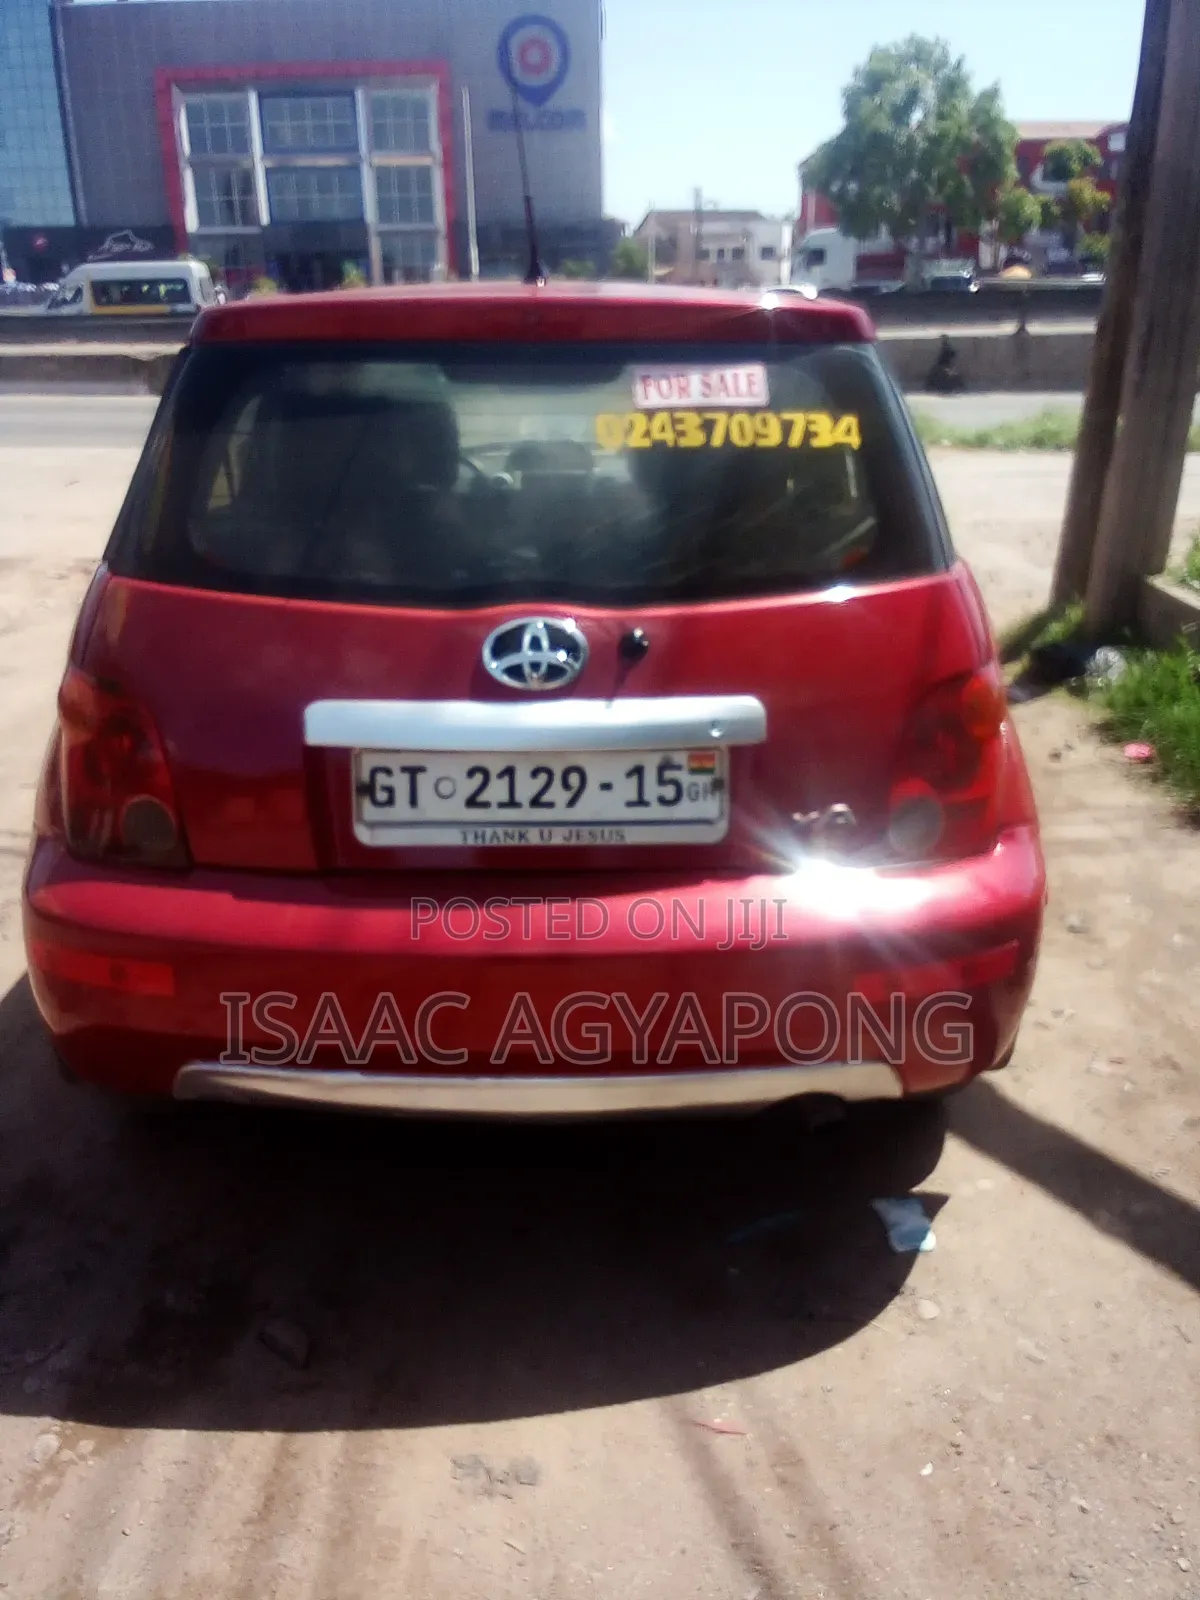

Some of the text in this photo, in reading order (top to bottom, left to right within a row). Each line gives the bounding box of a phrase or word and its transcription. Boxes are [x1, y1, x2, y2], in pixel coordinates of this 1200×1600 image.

[641, 372, 759, 400] FOR SALE
[595, 411, 862, 450] 0243709734
[369, 766, 427, 808] GT
[460, 828, 627, 845] THANK U JESUS
